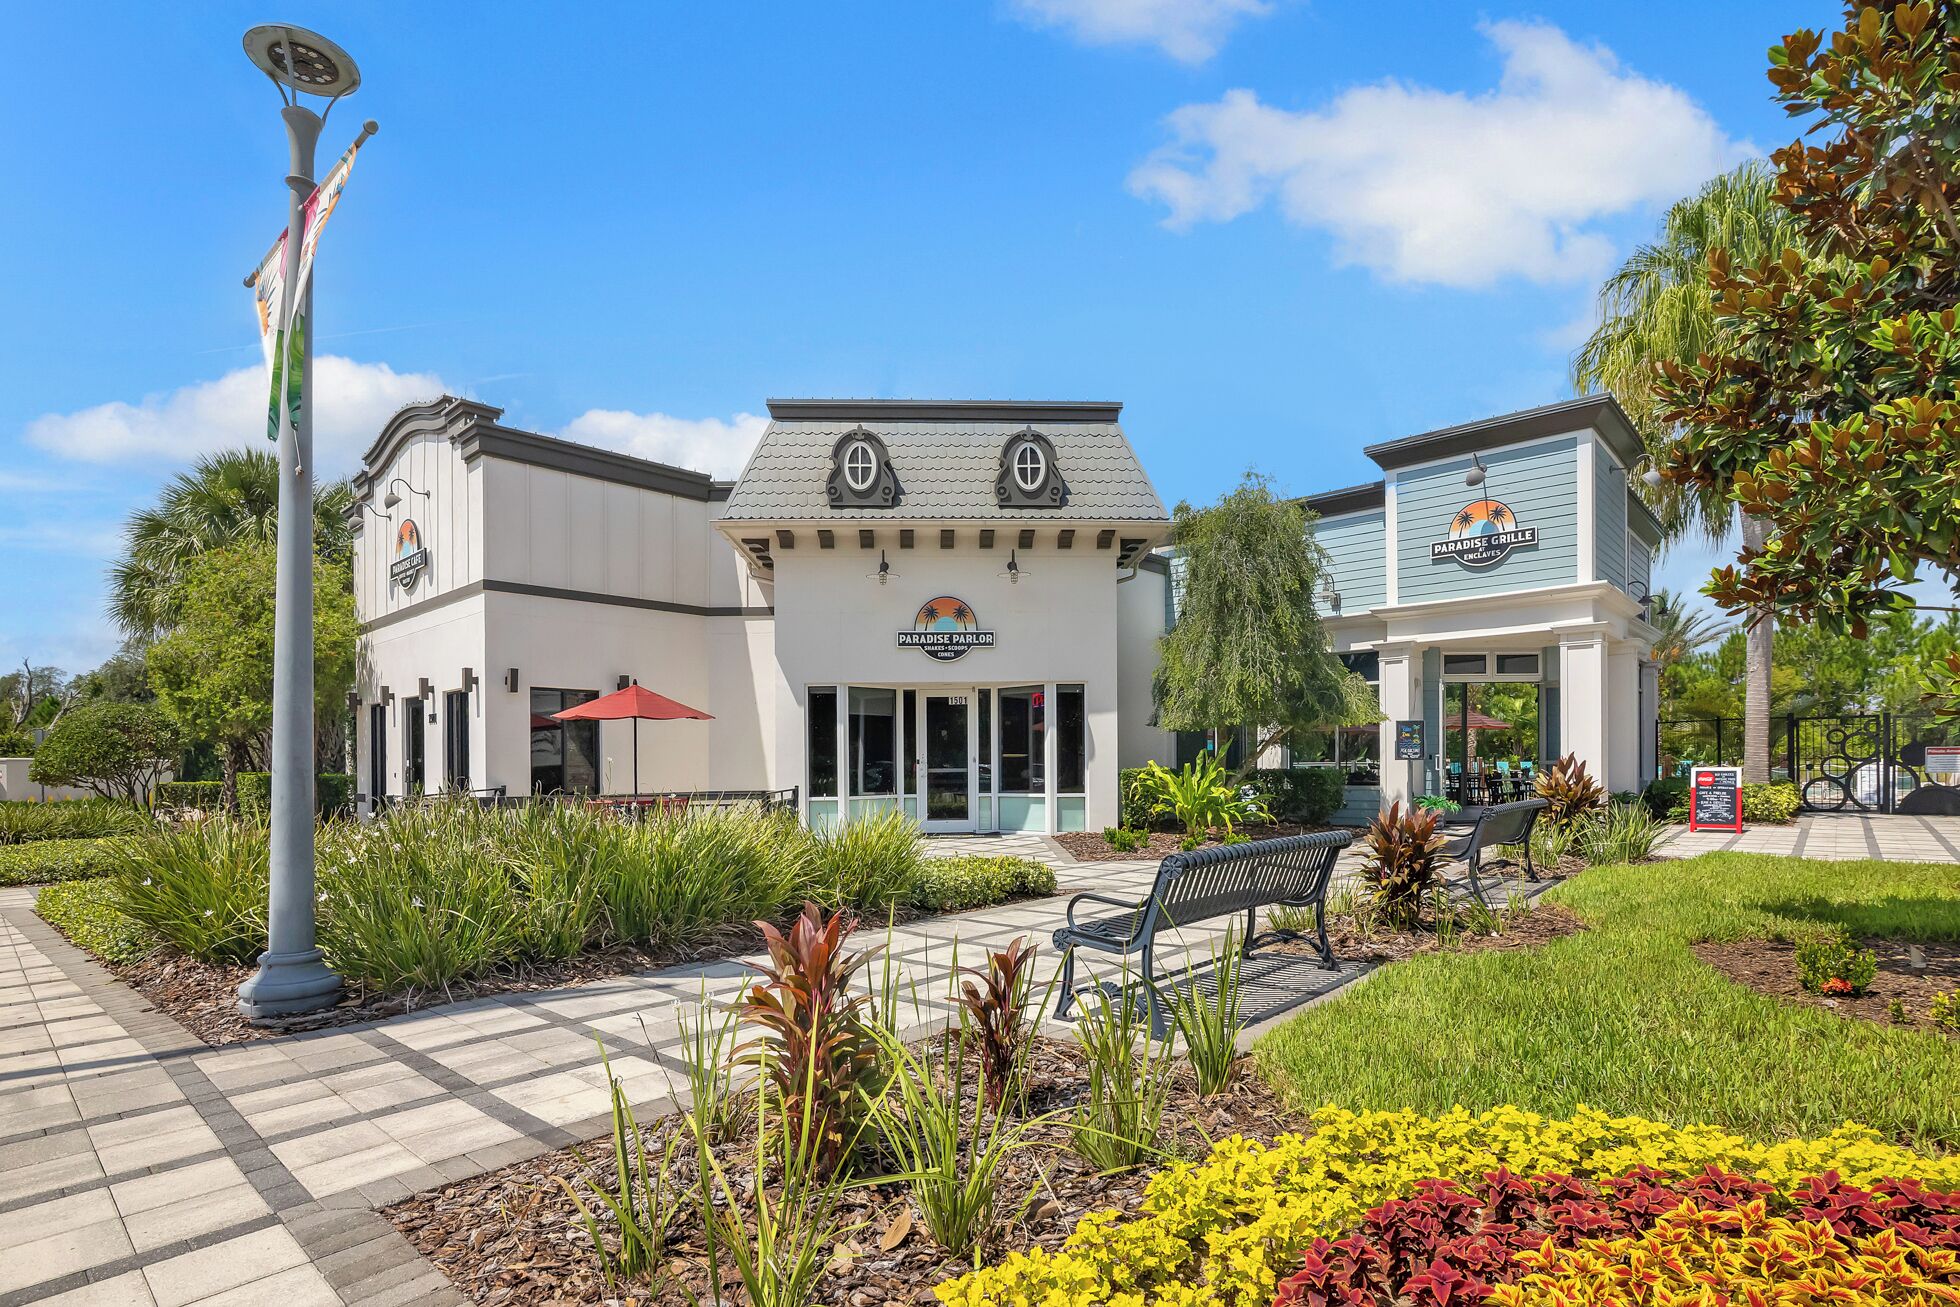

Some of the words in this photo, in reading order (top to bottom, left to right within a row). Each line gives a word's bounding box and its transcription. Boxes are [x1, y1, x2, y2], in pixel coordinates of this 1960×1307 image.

[1434, 537, 1489, 554] PARADISE
[1491, 530, 1533, 545] GRILLE
[1463, 549, 1501, 561] ENCLAVES
[392, 558, 411, 576] PARADISE
[899, 634, 951, 644] PARADISE
[952, 634, 993, 644] PARLOR
[949, 696, 968, 705] 1501
